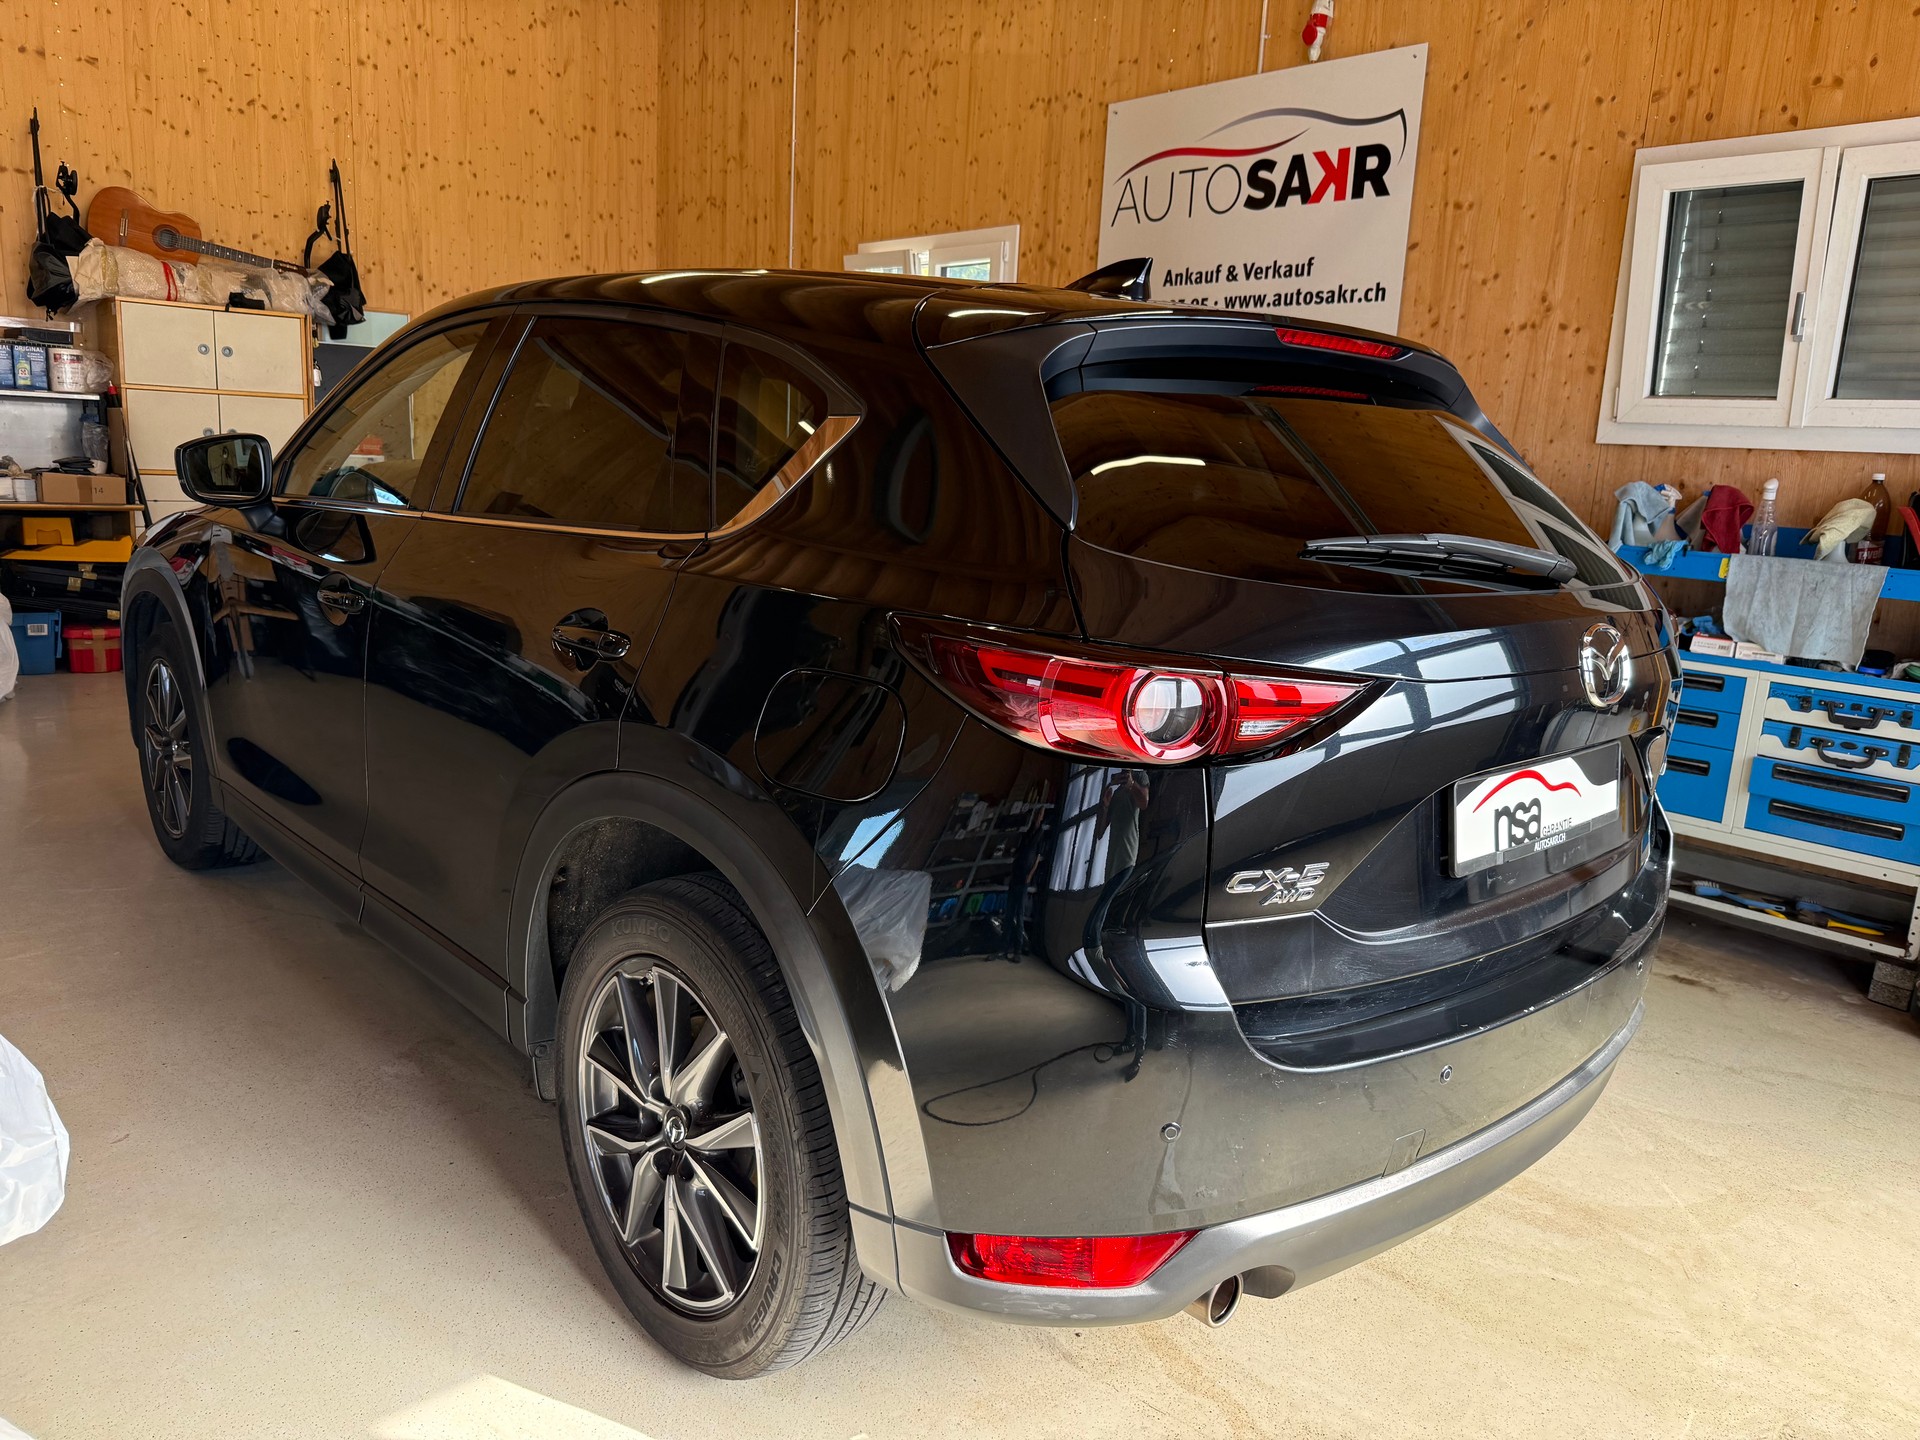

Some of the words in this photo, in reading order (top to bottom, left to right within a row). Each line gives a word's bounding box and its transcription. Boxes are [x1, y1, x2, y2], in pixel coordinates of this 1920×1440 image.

[1111, 143, 1391, 227] AUTOSAKR
[1163, 264, 1222, 287] Ankauf
[1226, 265, 1238, 282] &
[1243, 257, 1315, 281] Verkauf
[1223, 282, 1387, 309] www.autosakr.ch
[1494, 798, 1541, 852] nsa
[1542, 817, 1572, 836] GARANTIE
[1225, 862, 1330, 894] CX-5
[1259, 887, 1316, 906] AWD
[612, 917, 672, 943] KUMHO
[741, 1248, 782, 1343] CRUGEN
